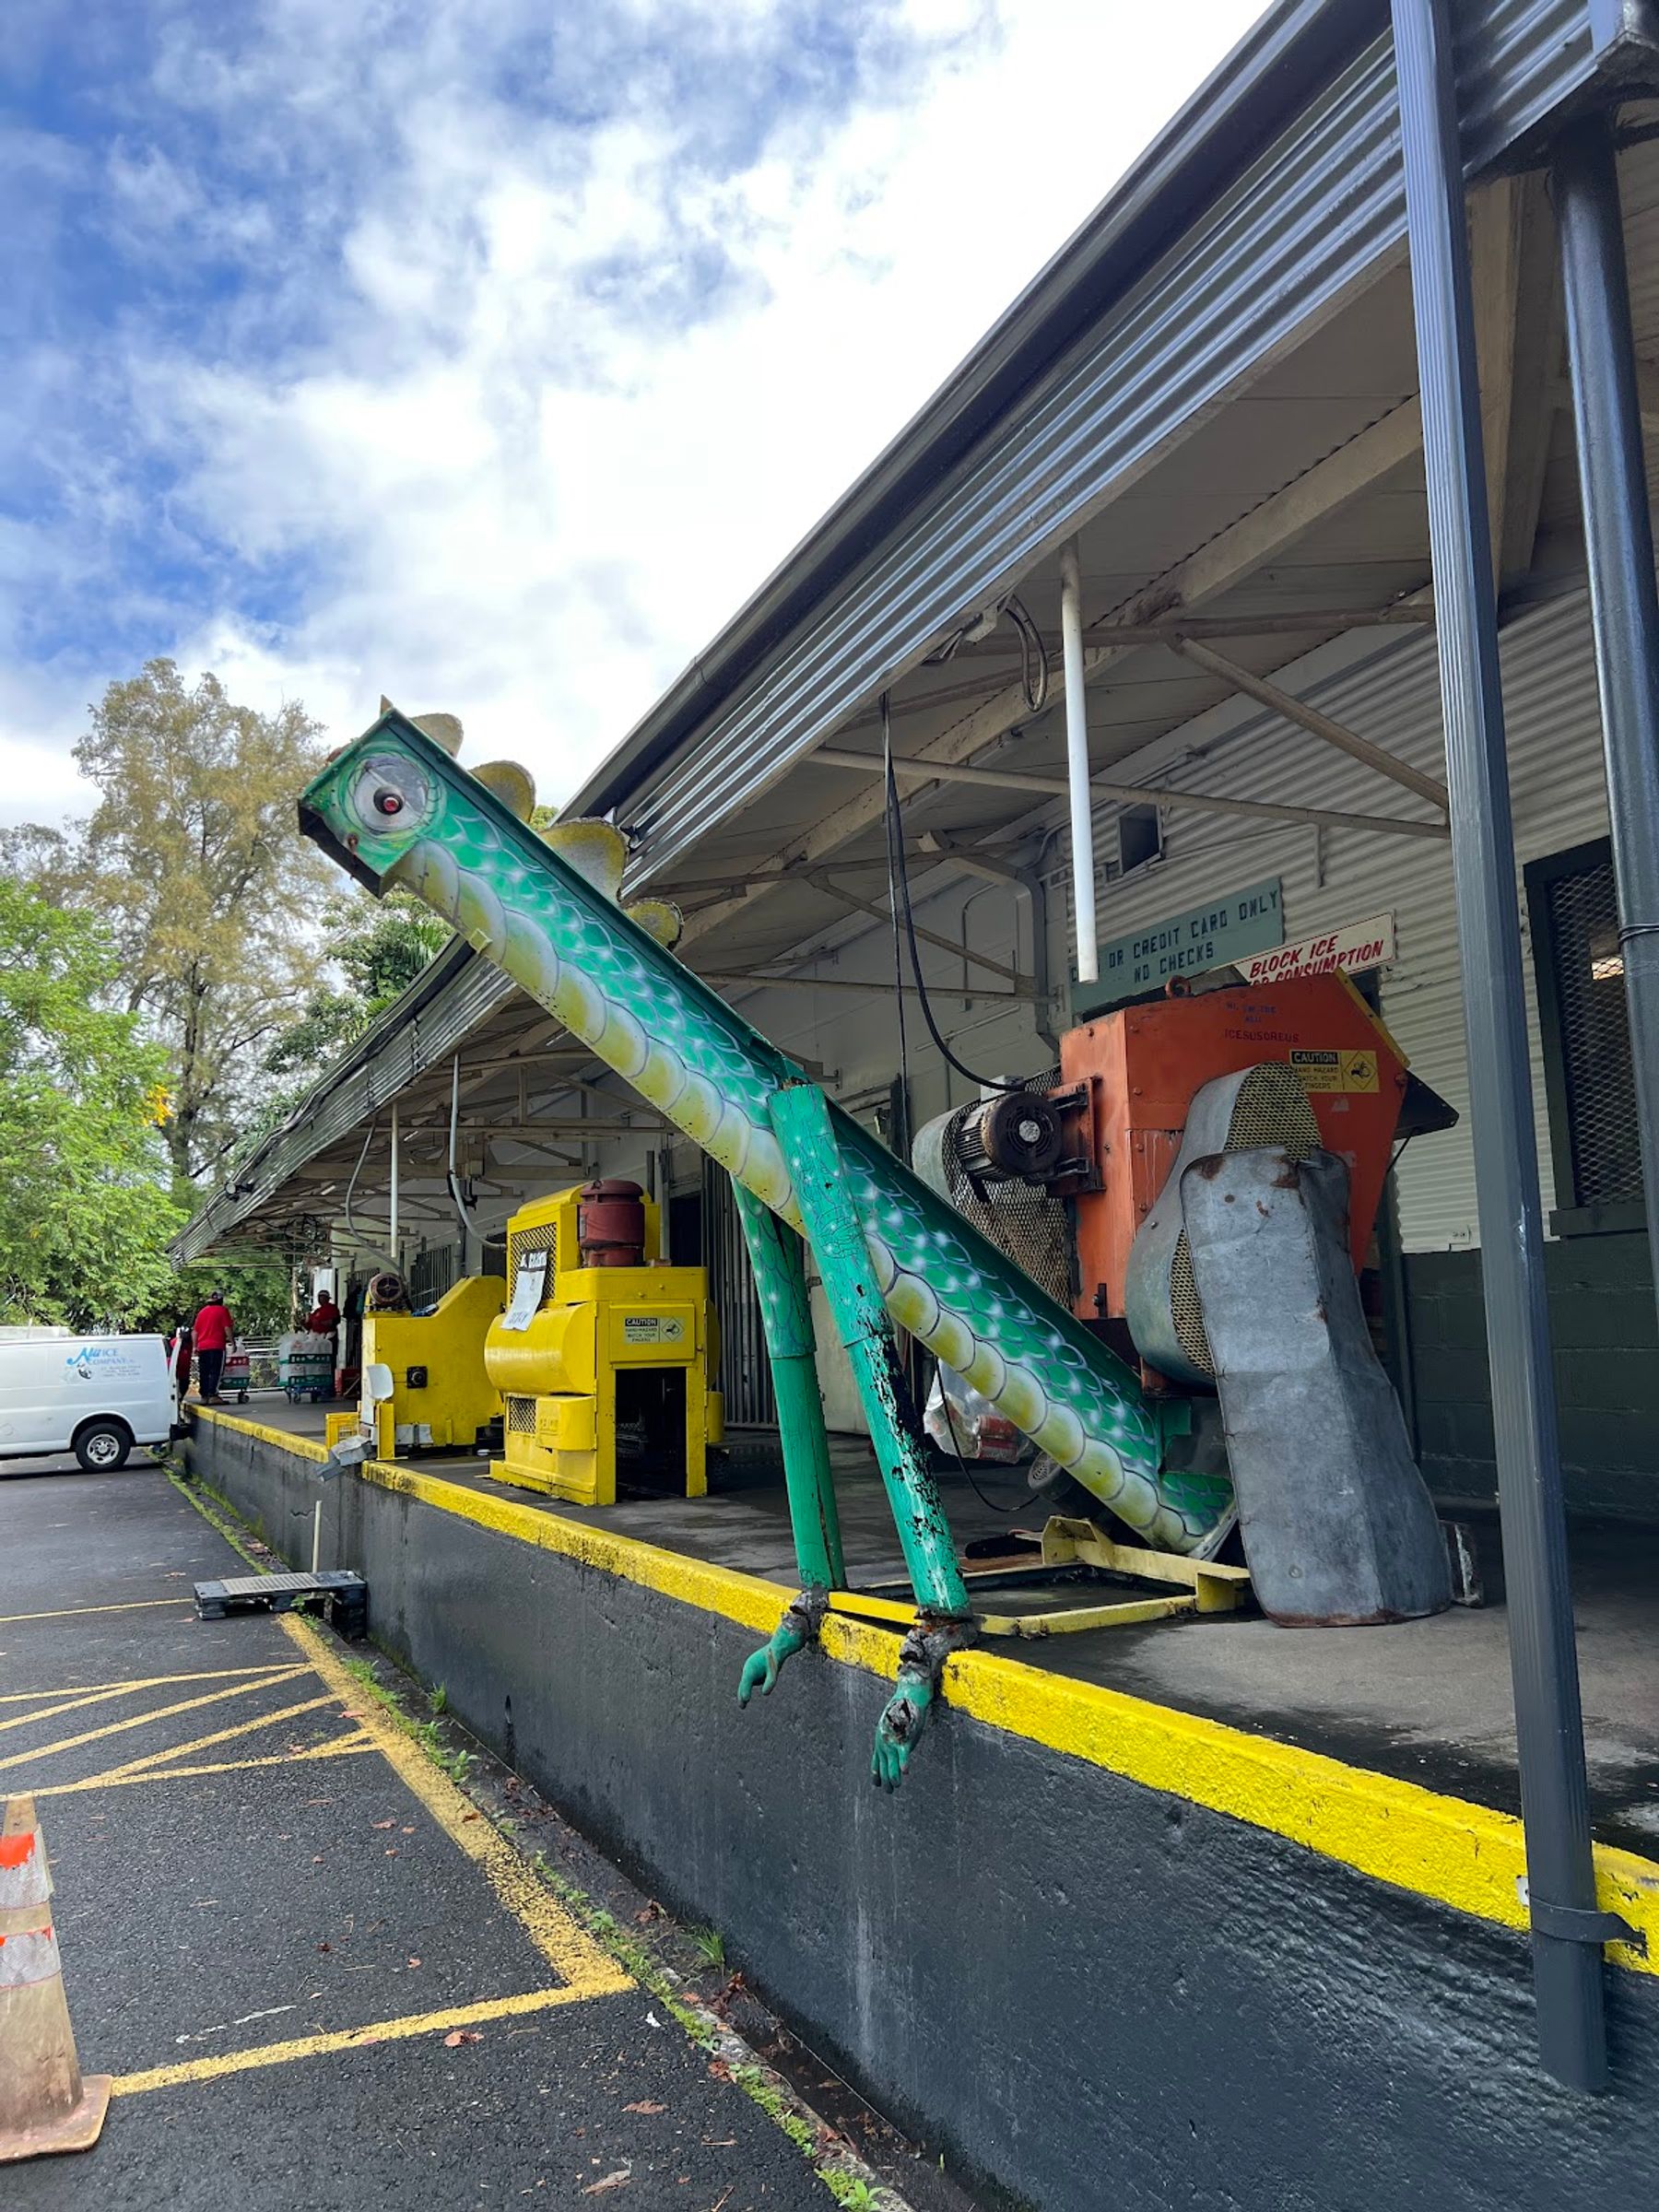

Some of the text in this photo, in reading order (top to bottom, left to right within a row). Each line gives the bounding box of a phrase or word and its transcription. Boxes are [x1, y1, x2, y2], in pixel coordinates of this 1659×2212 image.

[1109, 890, 1278, 968] OR CREDIT CARD ONLY
[1134, 941, 1214, 983] NO CHECKS
[1249, 935, 1339, 979] BLOCK ICE
[1293, 1052, 1336, 1064] CAUTION
[626, 1318, 656, 1326] CAUTION
[102, 1348, 119, 1357] ICE
